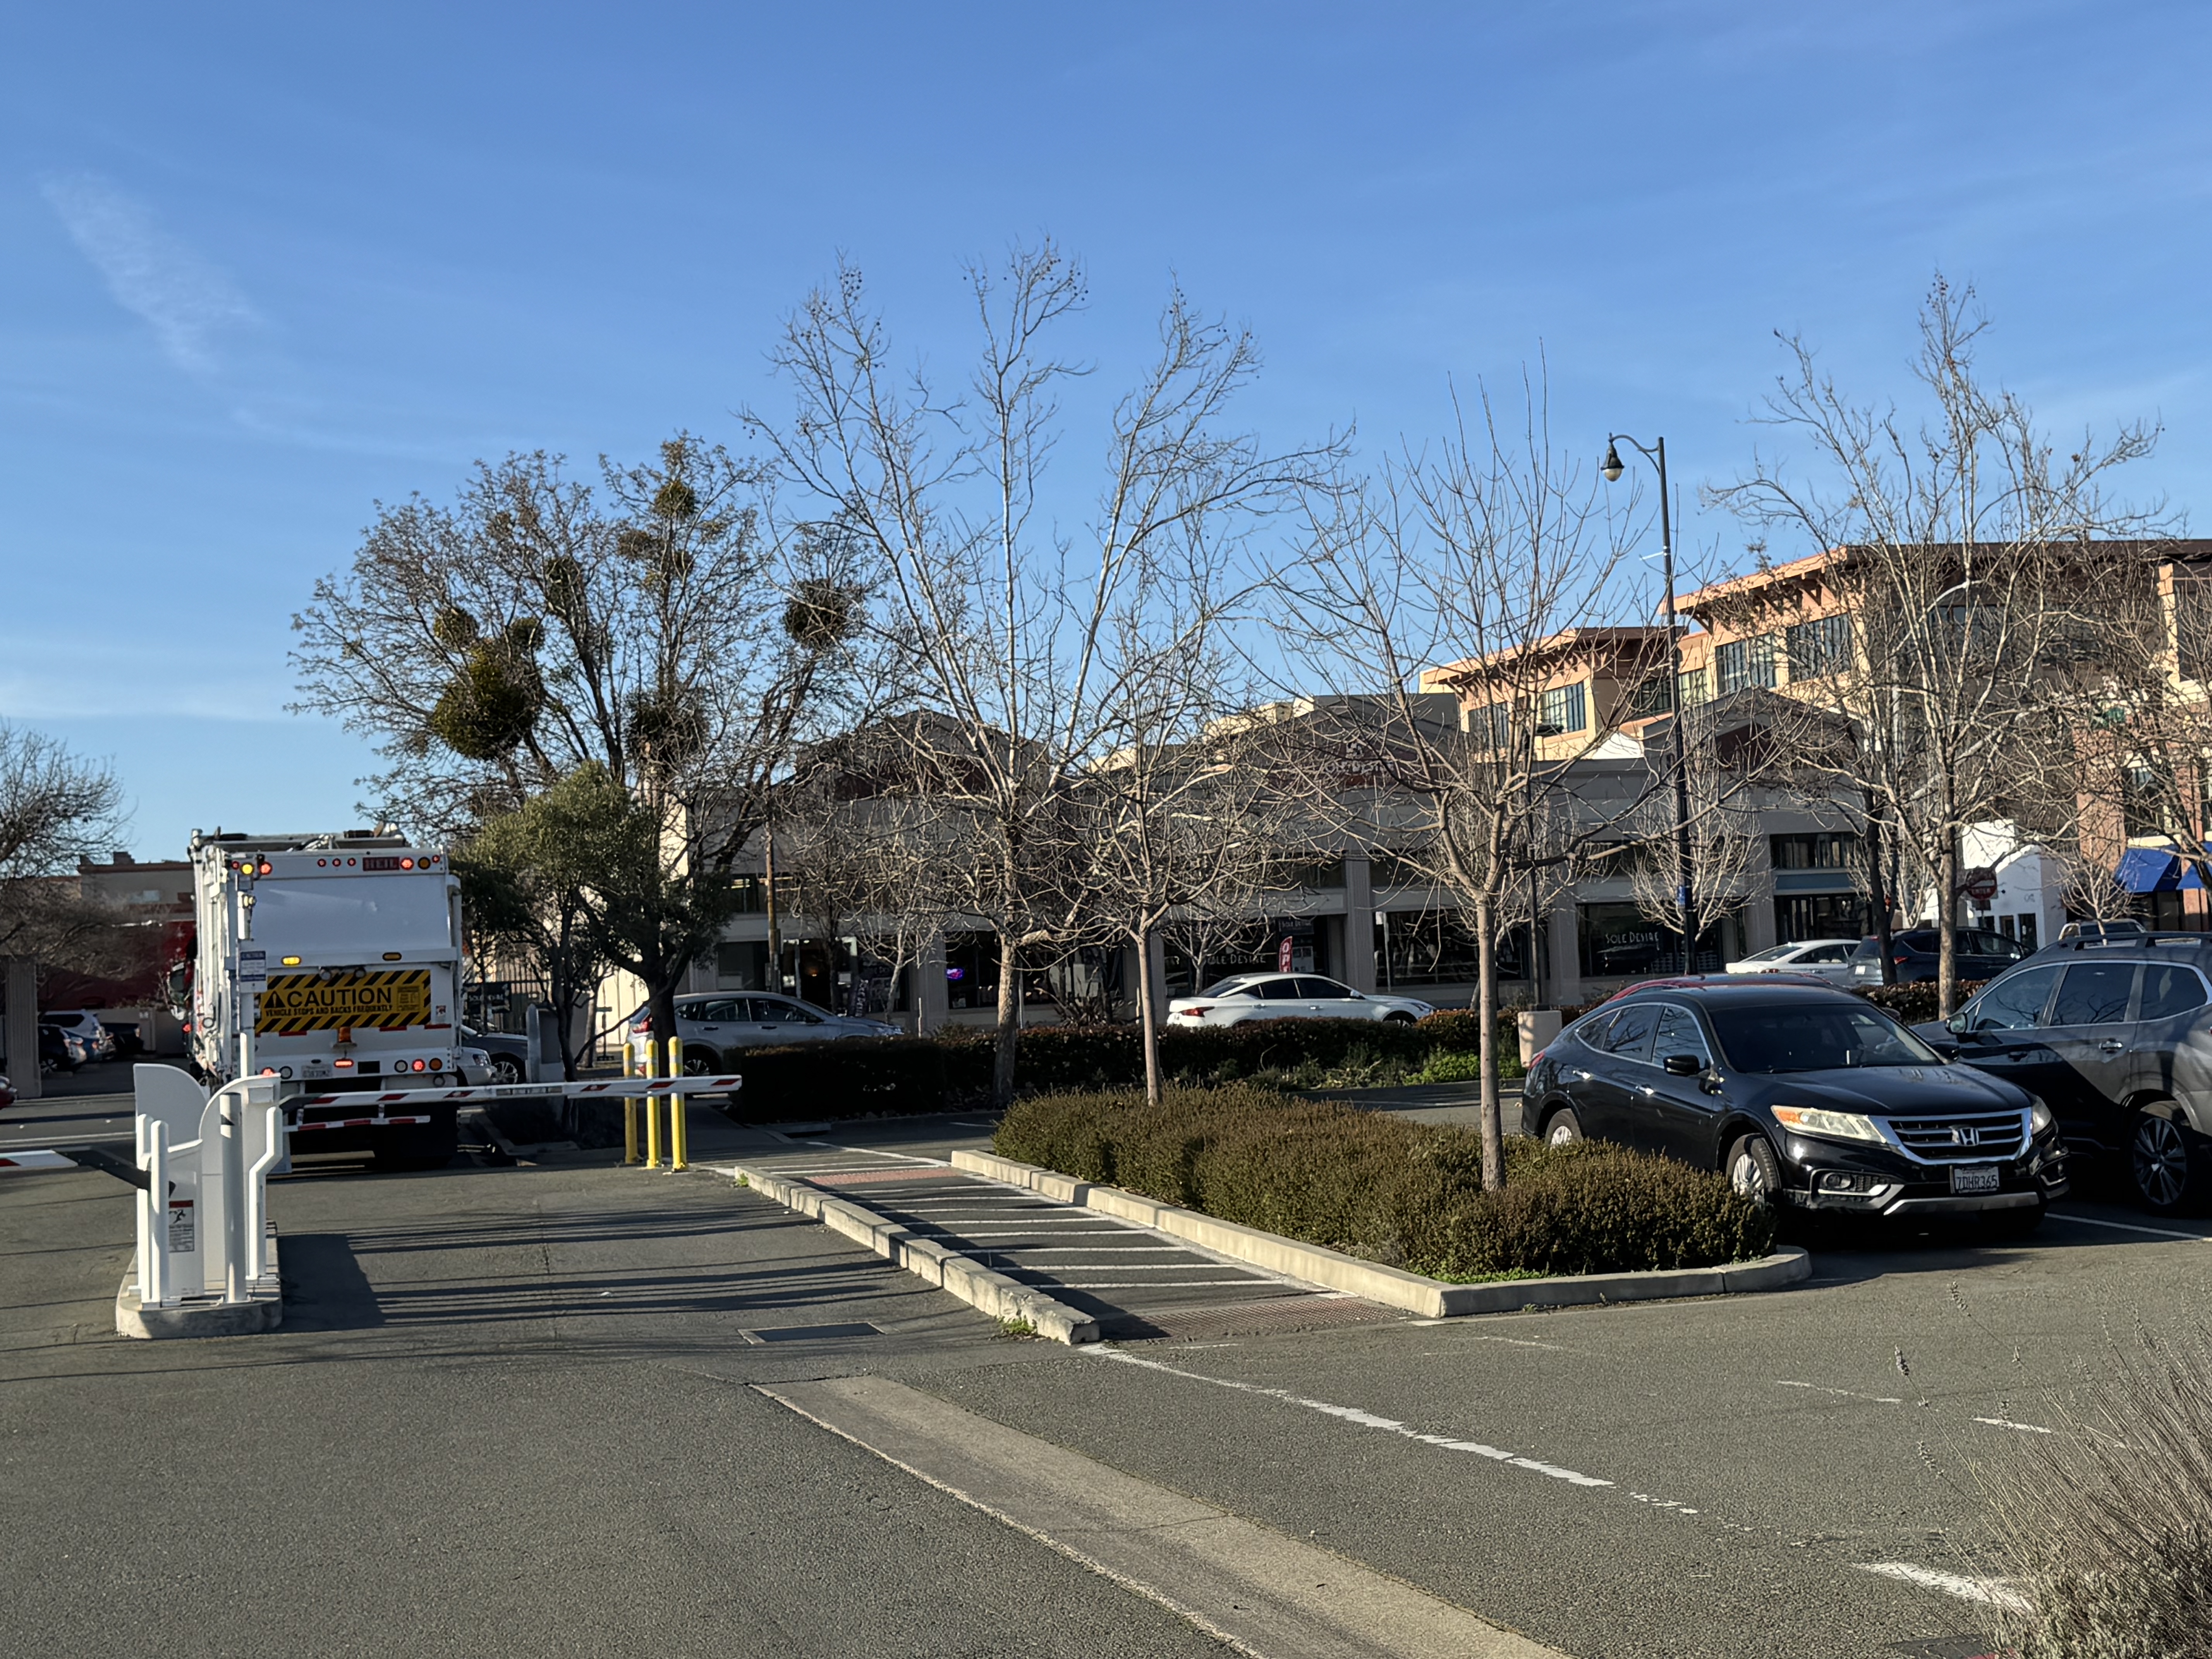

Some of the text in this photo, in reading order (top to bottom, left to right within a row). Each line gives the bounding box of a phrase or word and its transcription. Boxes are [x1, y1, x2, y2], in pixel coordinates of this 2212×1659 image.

[1605, 931, 1659, 944] SOLE DESIRE
[1281, 942, 1290, 972] OP
[287, 987, 392, 1007] CAUTION
[266, 1008, 291, 1017] VEHICLE
[331, 1006, 351, 1014] BACKS
[353, 1005, 392, 1013] FREQUENTLY
